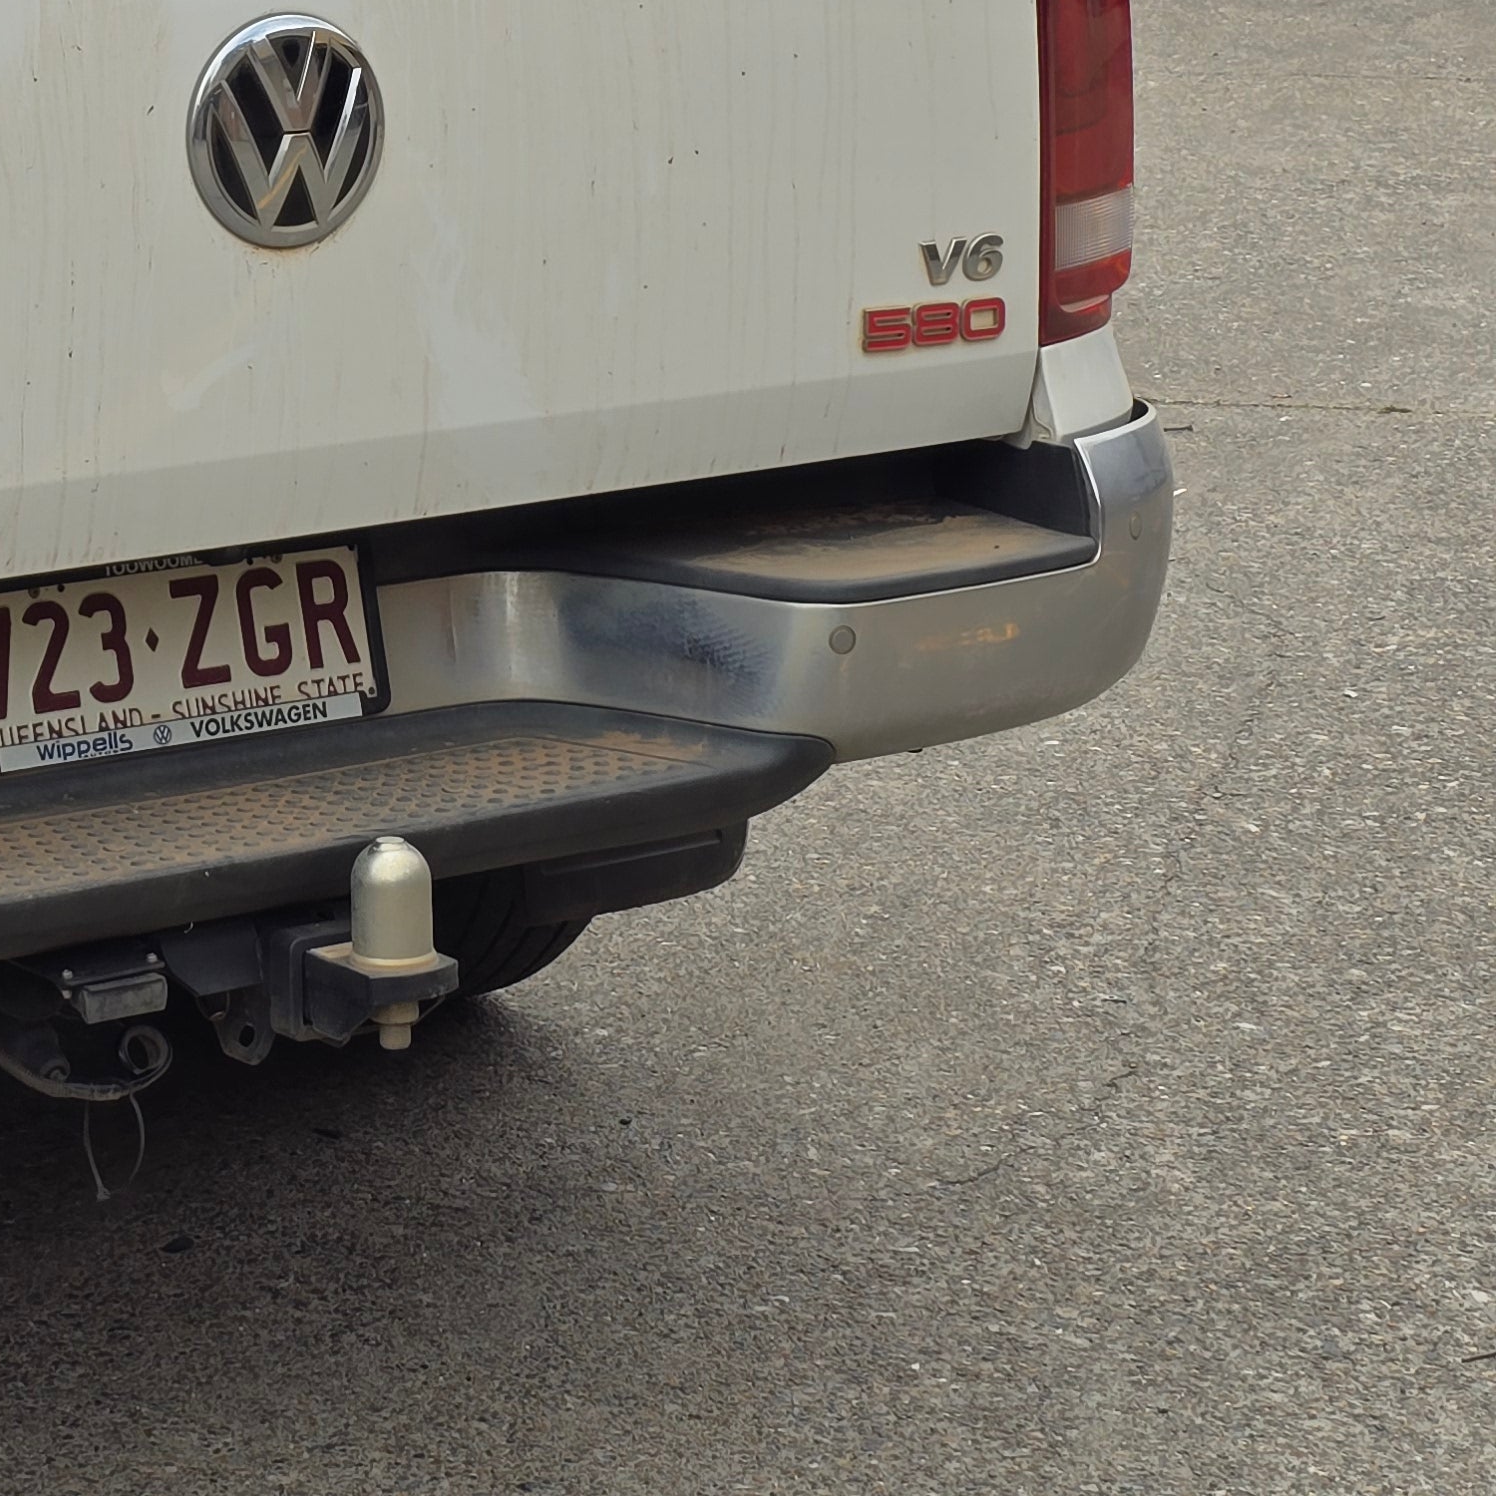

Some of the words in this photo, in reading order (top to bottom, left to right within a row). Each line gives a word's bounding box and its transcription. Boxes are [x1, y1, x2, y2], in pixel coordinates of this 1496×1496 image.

[918, 232, 1004, 287] V6
[862, 296, 1006, 353] 580
[172, 684, 281, 719] SUNSHINE
[297, 672, 364, 699] STATE
[36, 731, 134, 761] Wippells
[190, 701, 329, 738] VOLKSWAGEN
